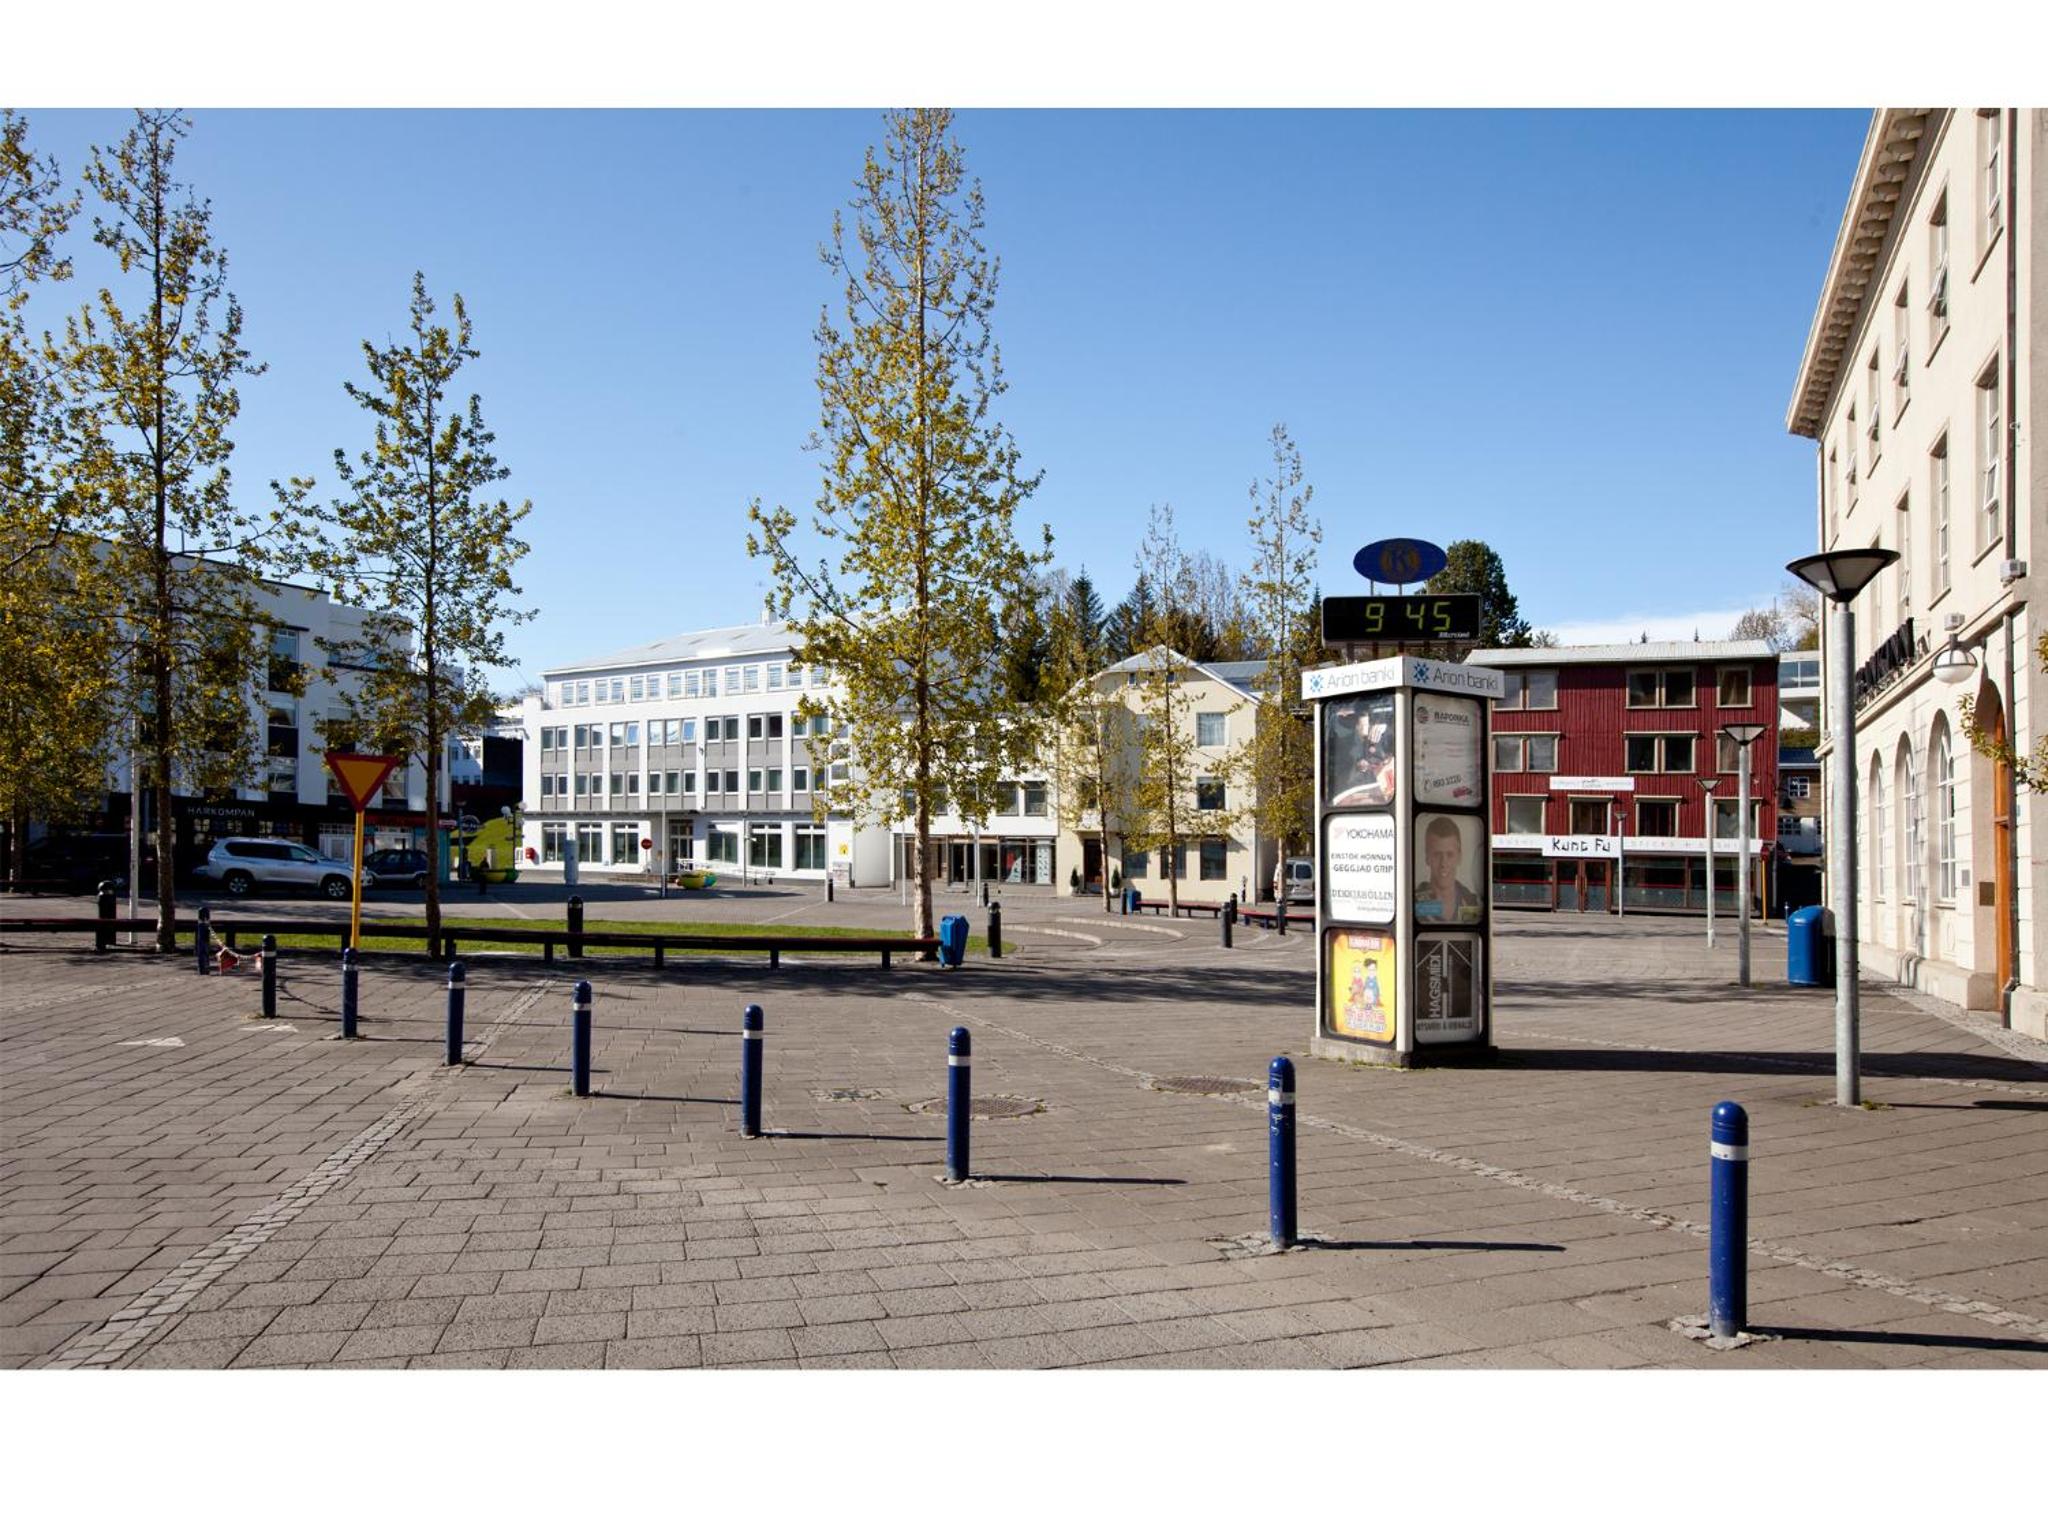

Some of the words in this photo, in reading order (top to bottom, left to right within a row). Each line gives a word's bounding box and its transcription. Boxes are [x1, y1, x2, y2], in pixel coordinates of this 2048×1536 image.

[1406, 601, 1452, 632] 45
[1327, 673, 1359, 689] Arion
[1360, 665, 1396, 685] banki
[1433, 667, 1466, 685] Arion
[1467, 671, 1498, 690] banki
[1346, 828, 1393, 840] YOKOHAMA
